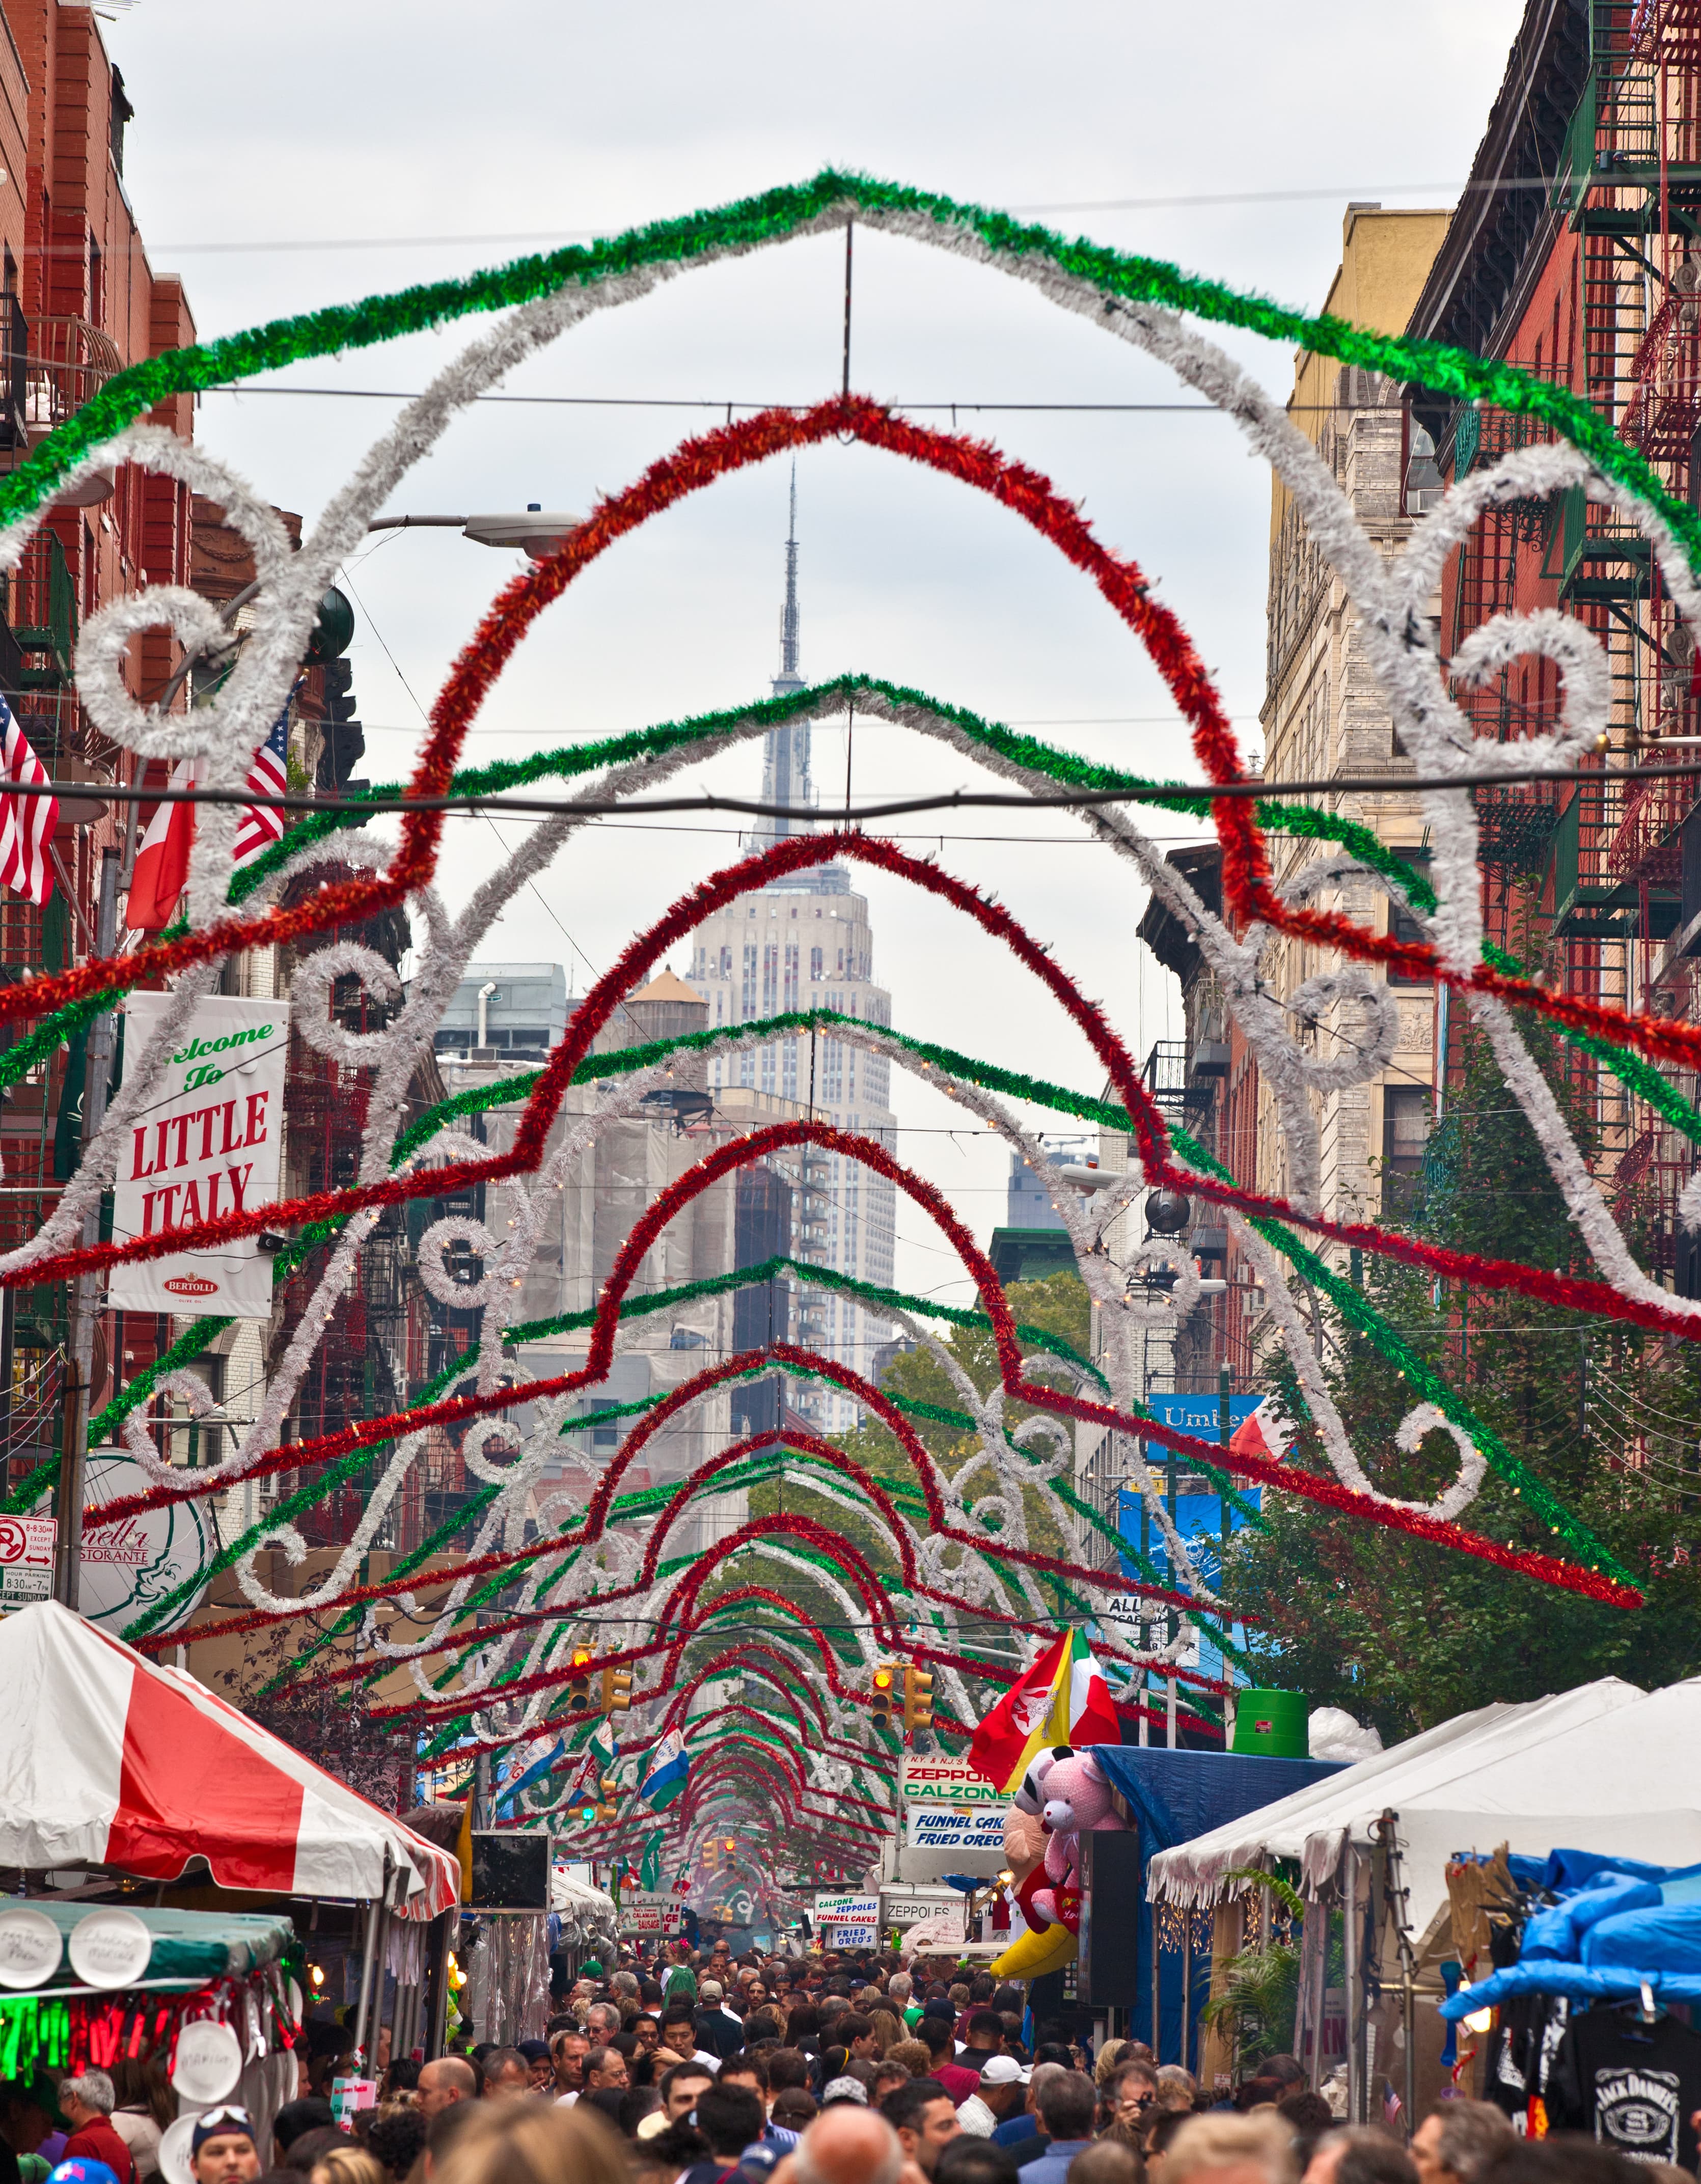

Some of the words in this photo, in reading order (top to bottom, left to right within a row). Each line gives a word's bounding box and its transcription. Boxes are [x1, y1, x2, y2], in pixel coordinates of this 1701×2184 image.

[164, 1024, 274, 1064] elcome
[183, 1063, 226, 1092] To
[130, 1091, 268, 1181] LITTLE
[142, 1163, 254, 1238] ITALY
[169, 1281, 214, 1292] BERTOLLI
[18, 1592, 45, 1601] SUNDAY
[916, 1815, 971, 1829] FUNNEL
[916, 1833, 961, 1845] FRIED
[819, 1897, 854, 1908] CALZONE
[836, 1902, 877, 1913] ZEPPOLES
[638, 1920, 660, 1930] SAUSAGE
[837, 1928, 866, 1938] FRIED
[838, 1936, 872, 1945] OREO'S
